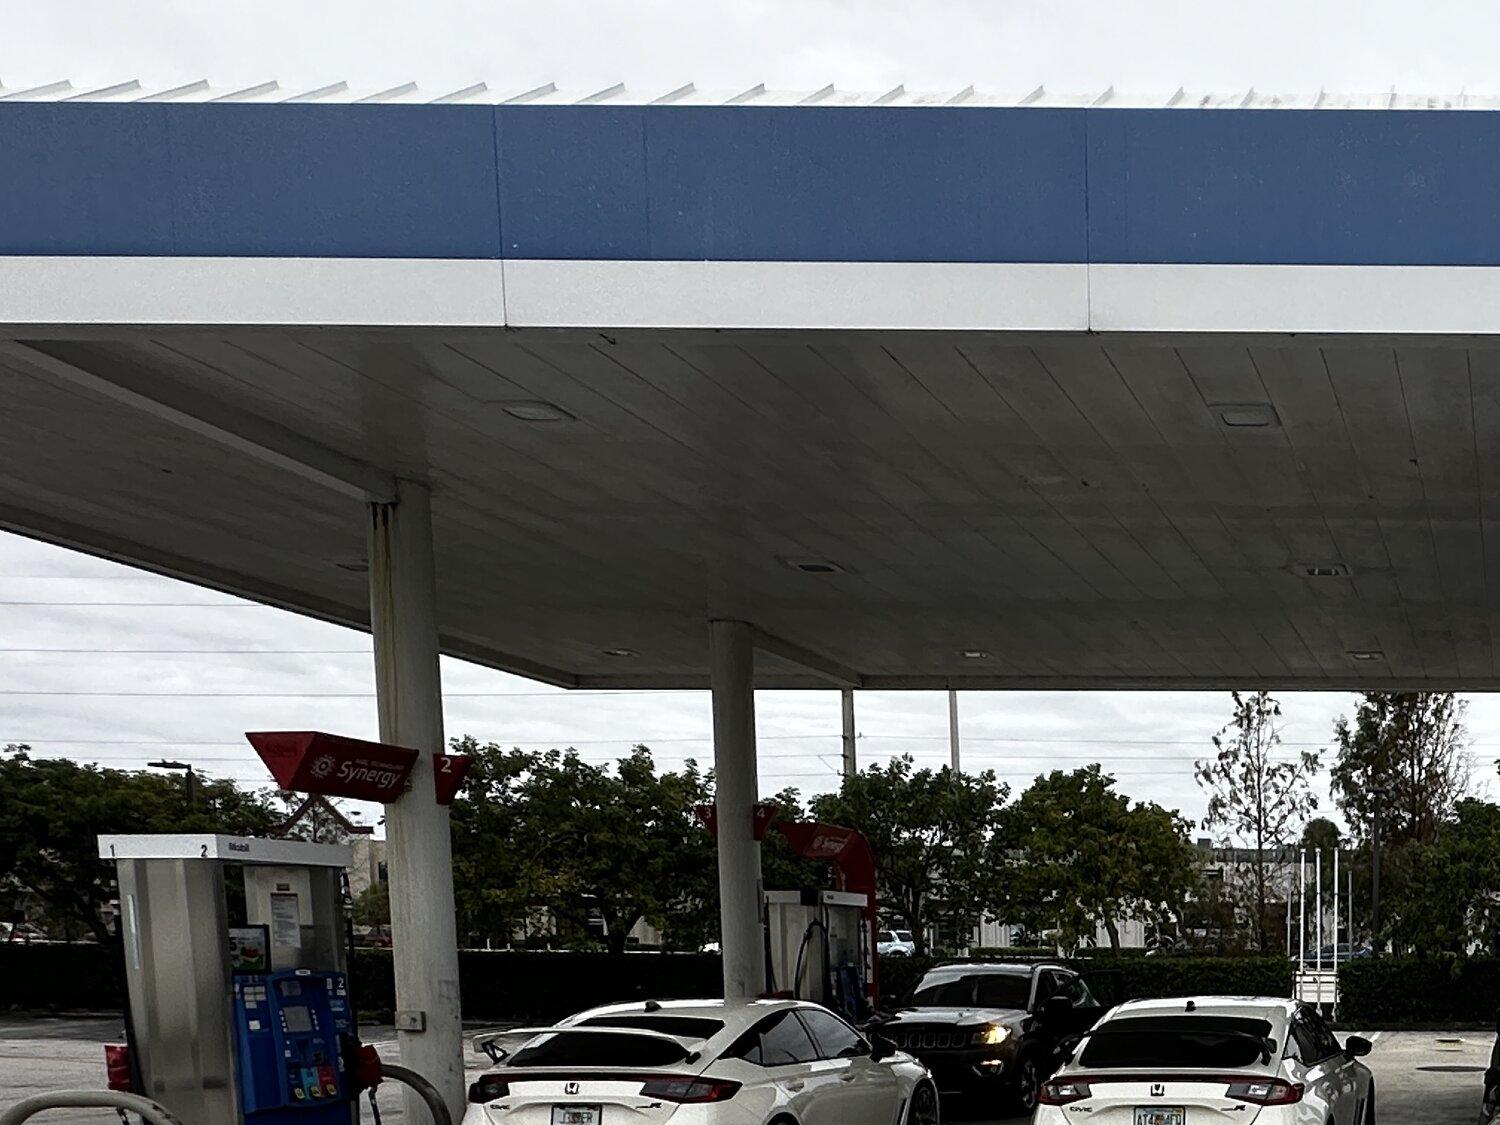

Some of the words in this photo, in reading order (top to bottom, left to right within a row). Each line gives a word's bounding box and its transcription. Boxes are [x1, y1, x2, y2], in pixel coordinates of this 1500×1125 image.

[441, 757, 451, 773] 2
[336, 760, 401, 789] Synergy
[704, 807, 712, 819] 3
[757, 807, 765, 819] 4
[109, 844, 116, 857] 1
[200, 844, 208, 858] 2
[337, 976, 345, 988] 2
